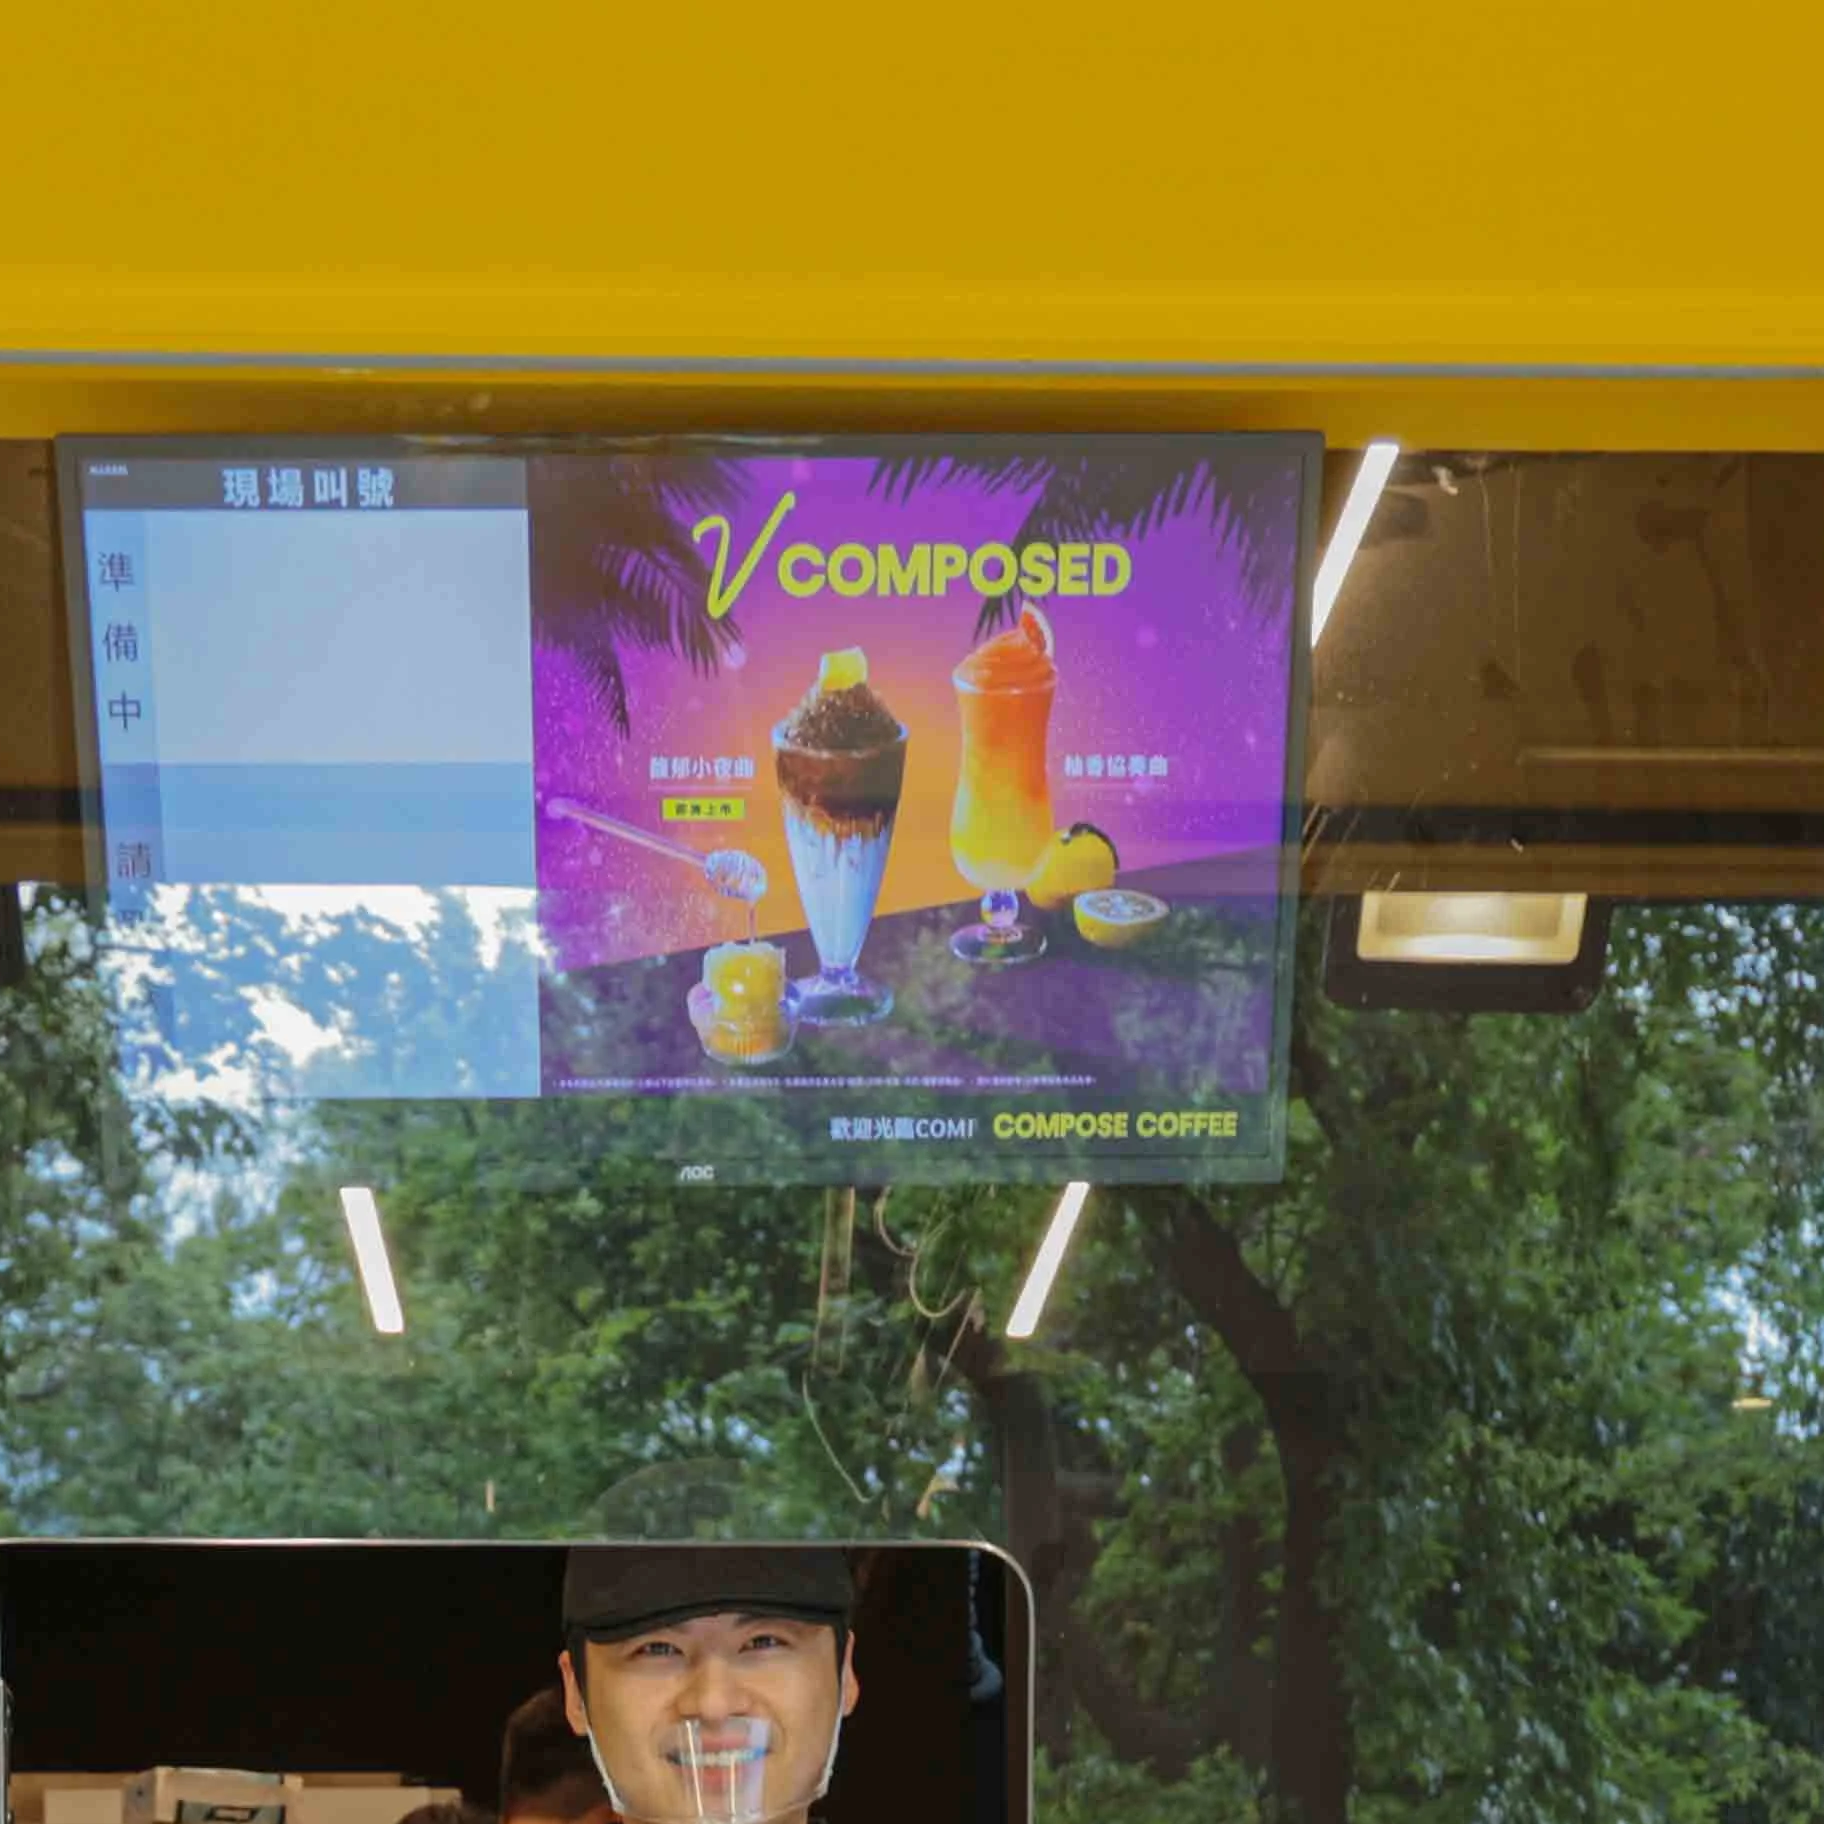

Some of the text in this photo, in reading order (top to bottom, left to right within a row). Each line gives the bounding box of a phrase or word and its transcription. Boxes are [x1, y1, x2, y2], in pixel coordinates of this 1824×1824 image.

[222, 467, 394, 508] 現場叫號
[693, 491, 1132, 620] V COMPOSED
[98, 551, 142, 730] 準備中
[992, 1111, 1238, 1139] COMPOSE COFFEE
[679, 1165, 714, 1180] AOC
